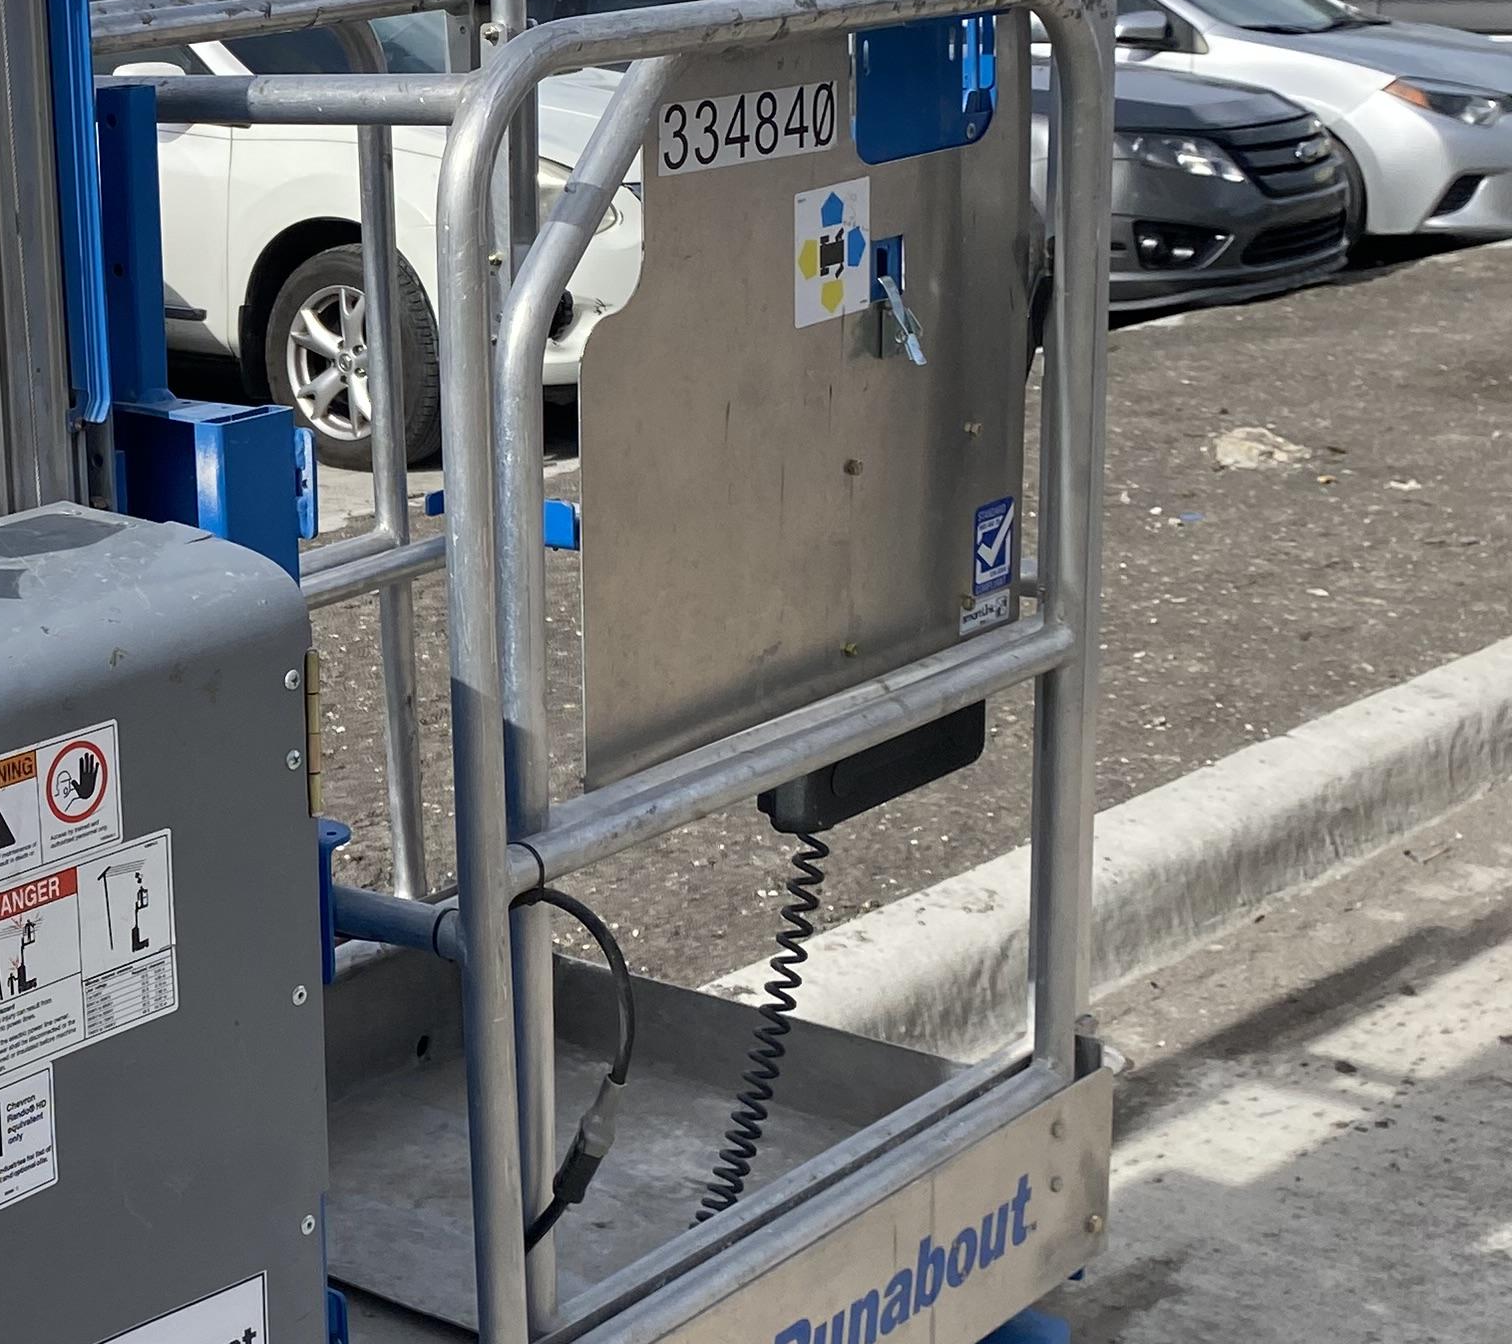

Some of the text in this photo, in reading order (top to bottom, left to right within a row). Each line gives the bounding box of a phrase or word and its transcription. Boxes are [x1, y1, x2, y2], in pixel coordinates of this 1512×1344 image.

[664, 81, 835, 170] 334840
[6, 1094, 35, 1112] Chevron
[35, 1100, 46, 1110] HD
[7, 1113, 43, 1134] equivalent
[7, 1133, 23, 1145] only
